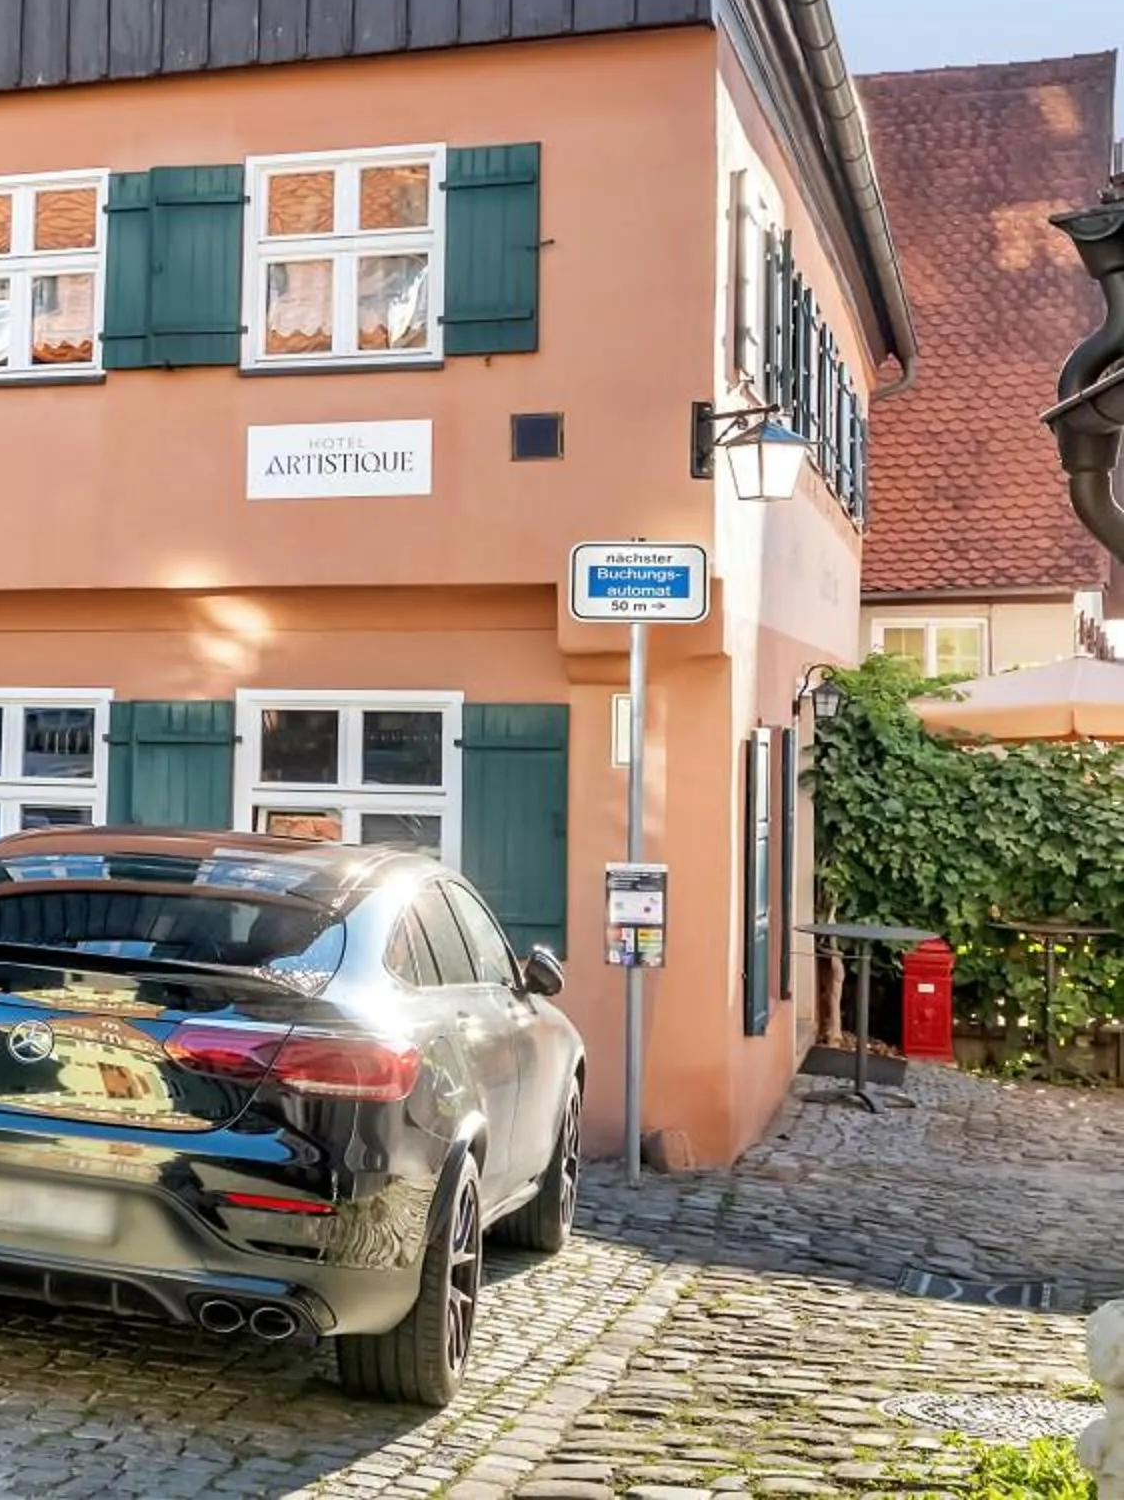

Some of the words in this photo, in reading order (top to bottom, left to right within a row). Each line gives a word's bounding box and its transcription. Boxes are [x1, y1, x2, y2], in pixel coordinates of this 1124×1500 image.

[309, 436, 367, 450] HOTEL
[265, 451, 414, 476] ARTISTIQUE
[606, 552, 673, 564] nächster
[597, 567, 684, 583] Buchungs-
[607, 585, 671, 597] automat
[611, 600, 628, 611] 50
[633, 602, 647, 611] m
